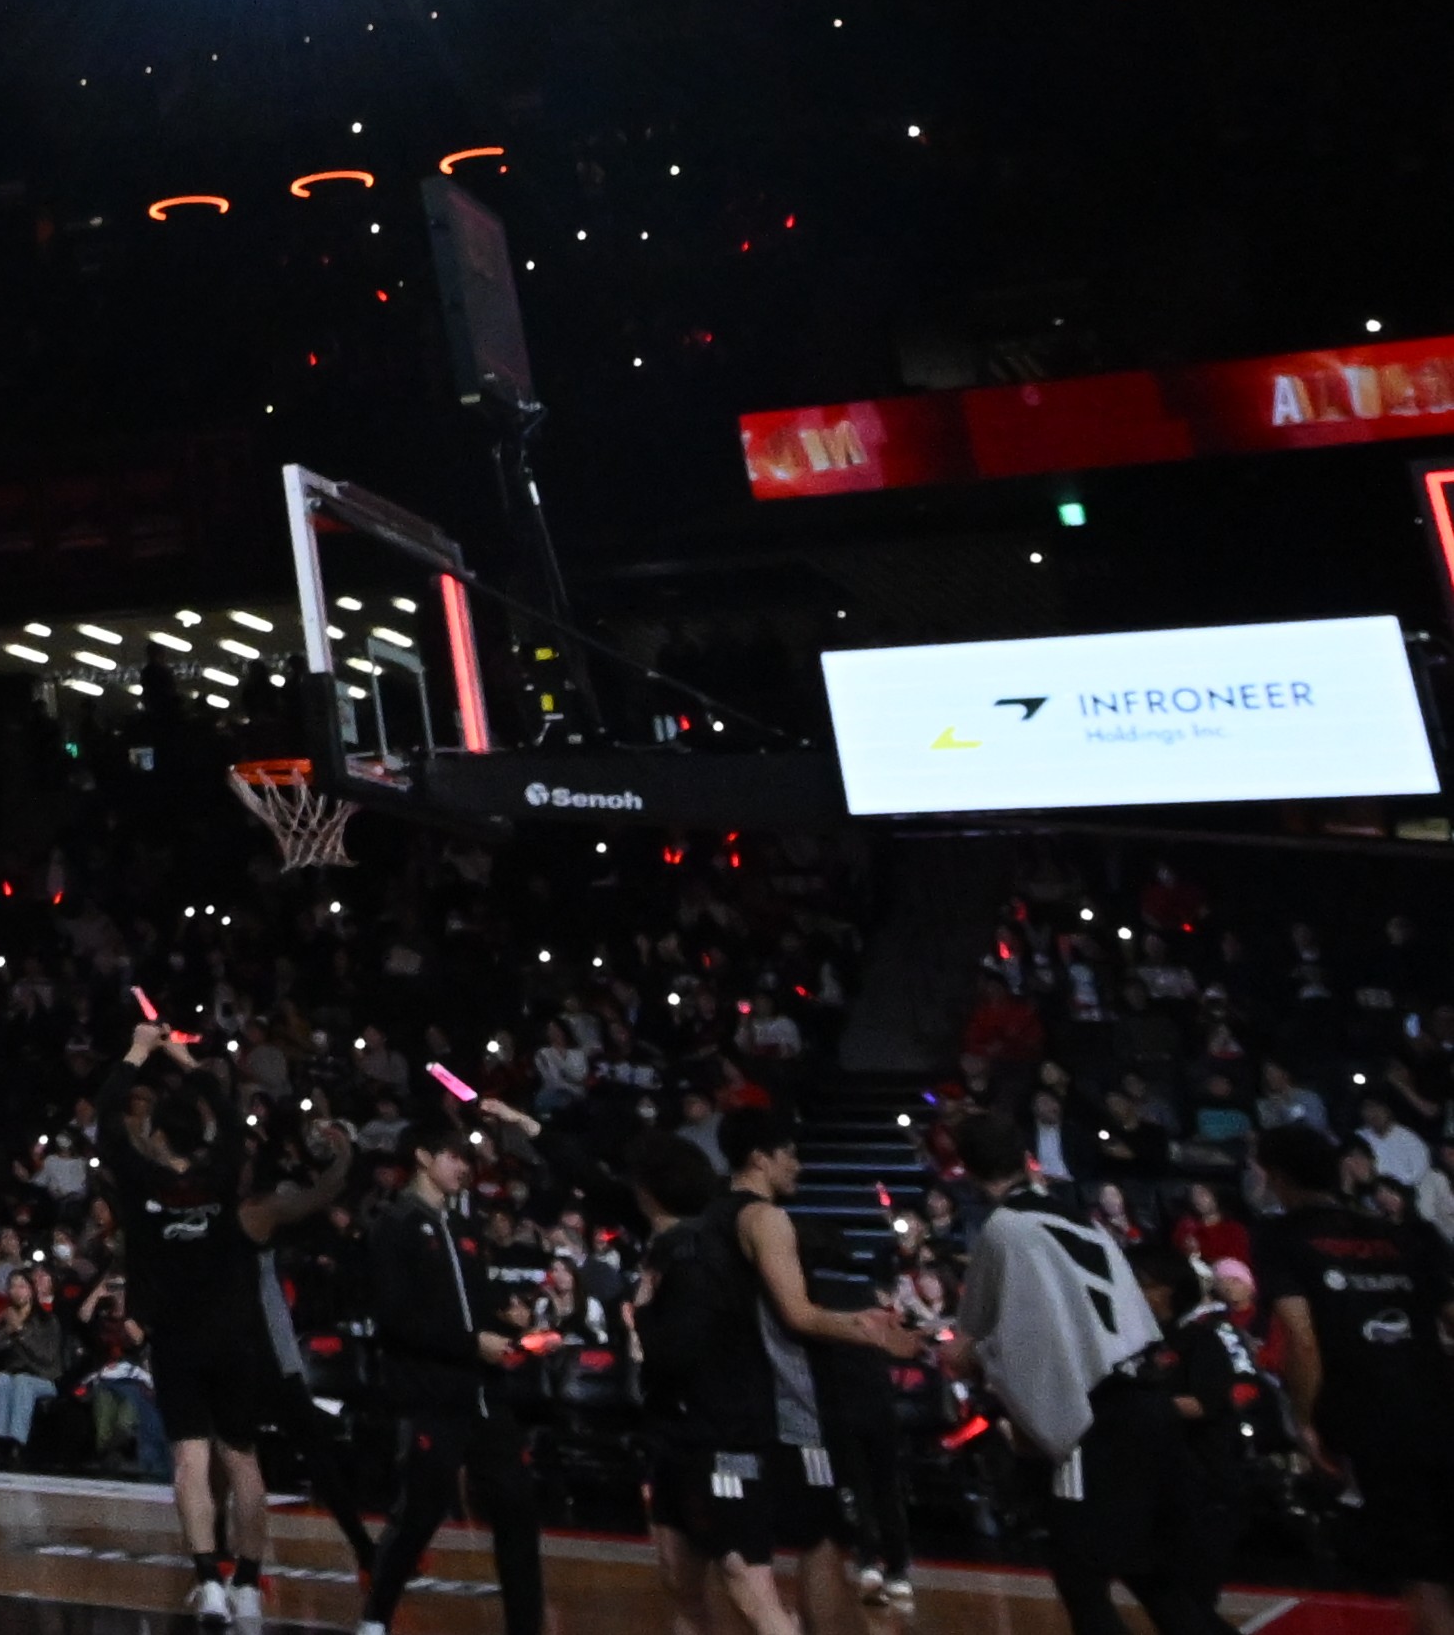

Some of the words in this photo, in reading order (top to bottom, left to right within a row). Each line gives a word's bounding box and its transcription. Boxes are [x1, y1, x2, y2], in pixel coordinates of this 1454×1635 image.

[1079, 680, 1316, 717] INFRONEER
[1085, 723, 1187, 746] Holdings
[550, 786, 644, 811] Senoh
